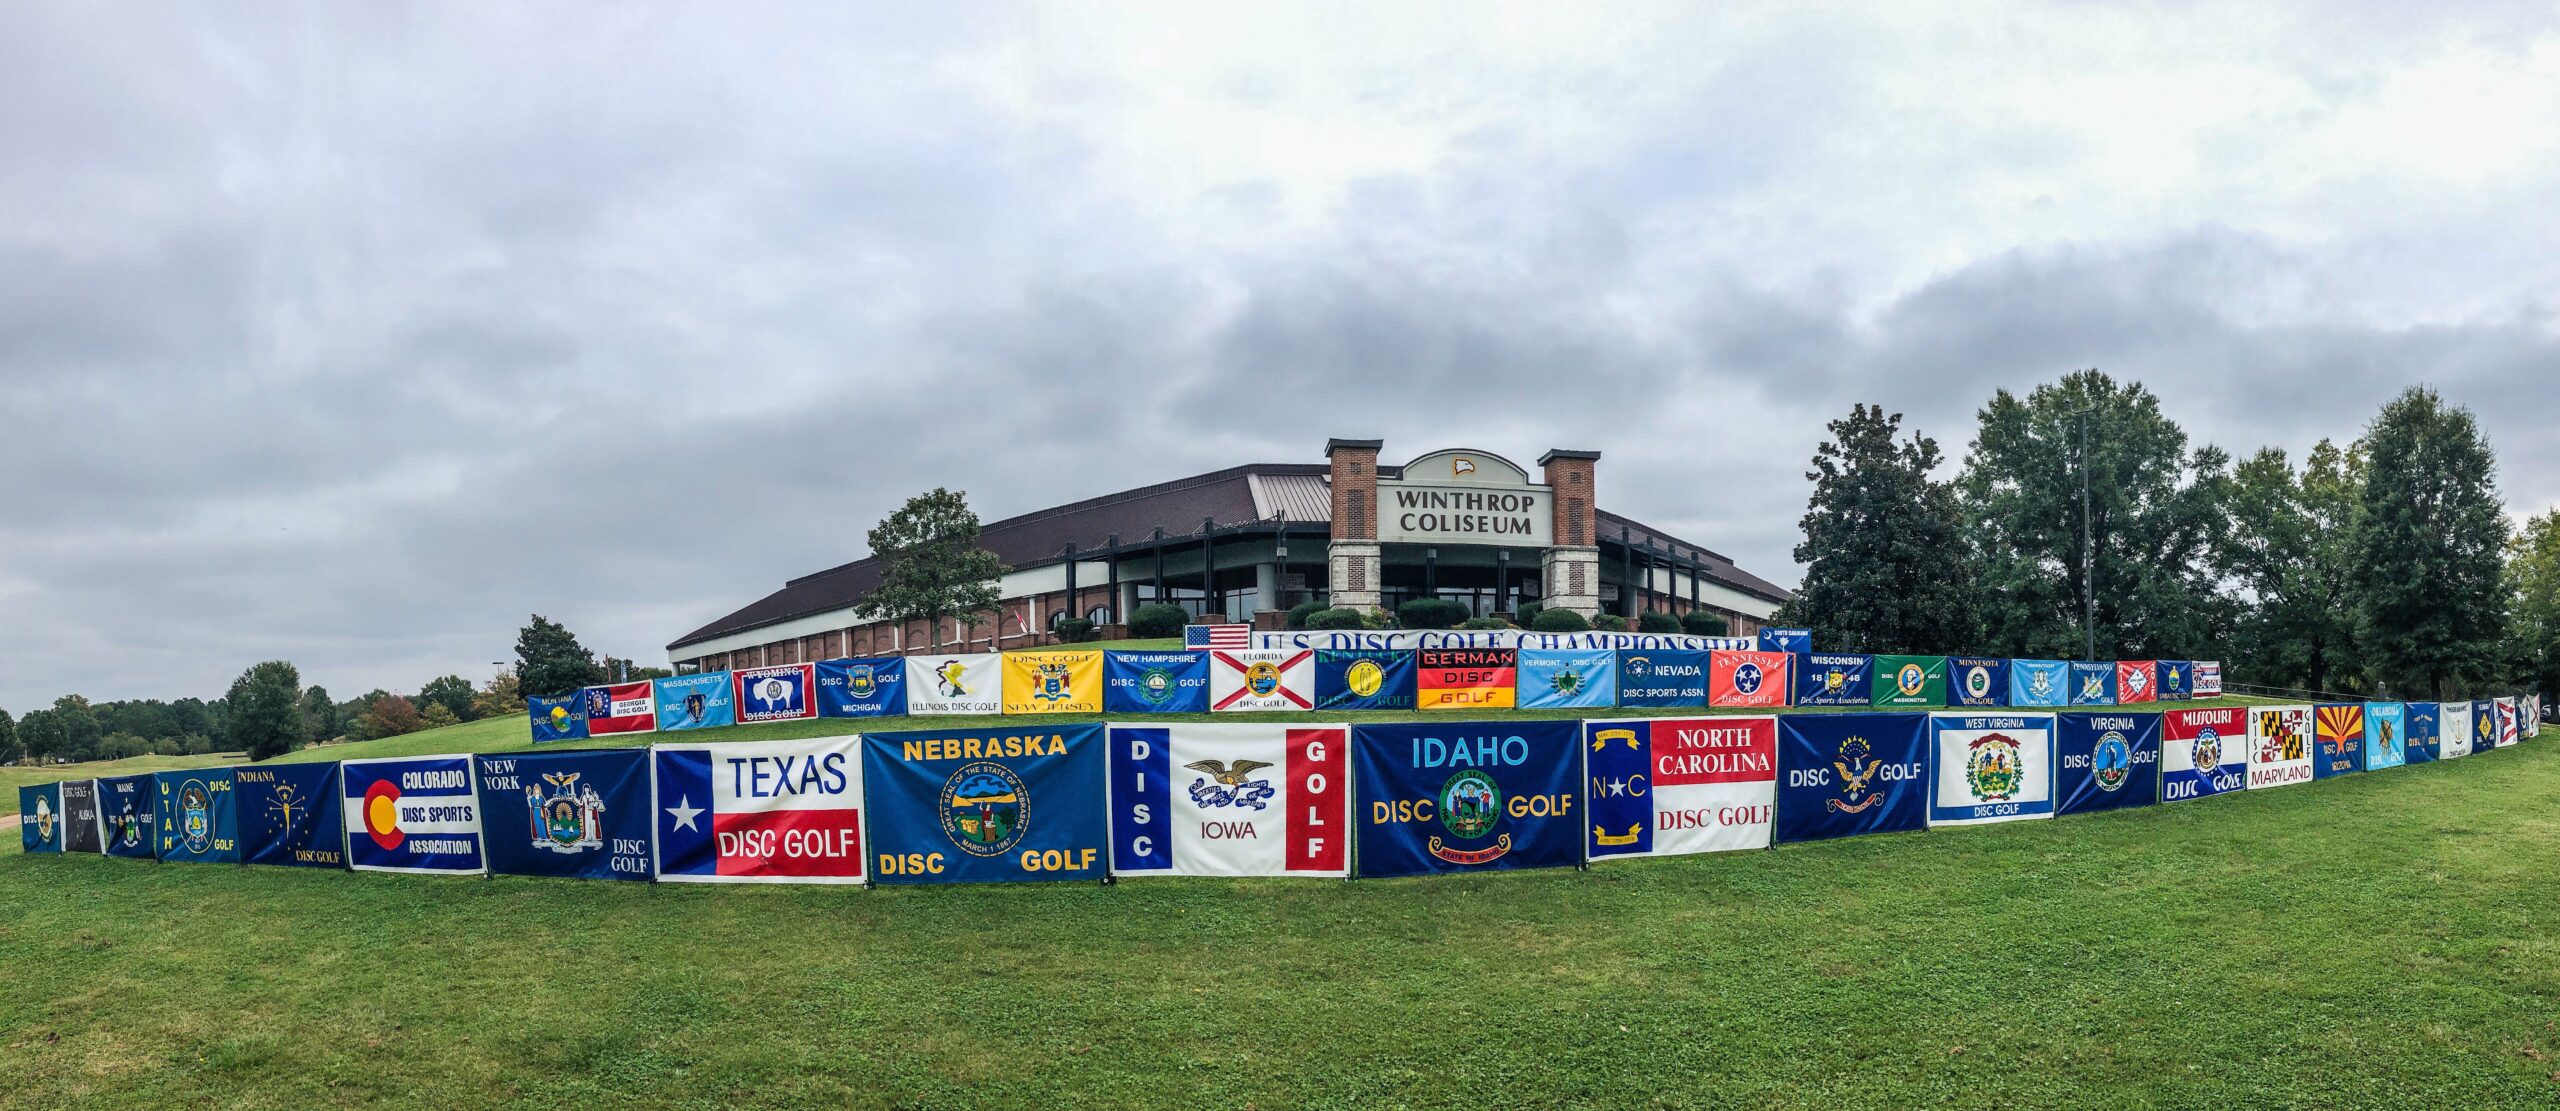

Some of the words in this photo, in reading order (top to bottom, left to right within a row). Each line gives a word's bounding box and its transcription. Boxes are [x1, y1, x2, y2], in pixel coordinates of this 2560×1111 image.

[1396, 490, 1535, 513] WINTHROP
[1400, 512, 1532, 535] COLISEUM
[1012, 655, 1047, 664] DISC
[1052, 654, 1095, 663] GOLF
[1117, 655, 1139, 663] NEW
[1141, 655, 1197, 663] HAMPSHIRE
[1423, 652, 1514, 665] GERMAN
[1524, 659, 1561, 667] VERMONT
[1572, 658, 1590, 666] DISC
[1592, 658, 1612, 666] GOLF
[1717, 654, 1781, 671] TENNESSEE
[1811, 656, 1864, 665] WISCONSIN
[1959, 659, 1999, 667] MINNESOTA
[746, 666, 800, 679] WYOMING
[1655, 665, 1701, 676] NEVADA
[2073, 662, 2113, 671] PENNSYLVANIA
[663, 675, 723, 688] MASSACHUSETTS
[821, 676, 842, 686] DISC
[878, 674, 900, 683] GOLF
[1111, 678, 1135, 687] DISC
[1179, 679, 1206, 687] GOLF
[1444, 671, 1493, 683] DISC
[1811, 674, 1822, 682] 18
[1440, 692, 1496, 703] GOLF
[1623, 689, 1644, 698] DISC
[1646, 689, 1677, 698] SPORTS
[1680, 688, 1705, 697] ASSN.
[619, 700, 646, 708] GEORGIA
[709, 698, 729, 707] GOLF
[1239, 700, 1260, 708] DISC
[1263, 700, 1288, 708] GOLF
[1377, 695, 1411, 706] GOLF
[1721, 695, 1746, 704] DISC
[1748, 695, 1774, 704] GOLF
[1814, 697, 1835, 705] Sports
[1837, 696, 1869, 704] Association
[1978, 697, 1995, 705] GOLF
[616, 707, 630, 715] DISC
[842, 703, 881, 712] MICHIGAN
[912, 702, 948, 711] ILLINOIS
[951, 702, 971, 711] DISC
[974, 702, 998, 711] GOLF
[1006, 703, 1042, 711] NEW
[1044, 702, 1097, 711] JERSEY
[747, 710, 772, 720] DISC
[775, 708, 803, 719] GOLF
[2182, 710, 2232, 727] MISSOURI
[533, 716, 551, 726] DISC
[1965, 718, 1986, 729] WEST
[1988, 718, 2025, 729] VIRGINIA
[2090, 717, 2135, 731] VIRGINIA
[1677, 728, 1752, 749] NORTH
[903, 734, 1068, 762] NEBRASKA
[1412, 736, 1529, 769] IDAHO
[2346, 742, 2358, 752] GOLF
[1658, 752, 1771, 775] CAROLINA
[2064, 754, 2089, 769] DISC
[2132, 750, 2157, 764] GOLF
[483, 759, 517, 775] NEW
[965, 766, 980, 775] THE
[983, 766, 1006, 778] STATE
[237, 771, 275, 783] INDIANA
[402, 770, 465, 790] COLORADO
[727, 752, 847, 798] TEXAS
[955, 774, 964, 784] OF
[1006, 776, 1017, 785] OF
[1445, 772, 1464, 791] GREAT
[1468, 771, 1485, 780] SEAL
[1790, 768, 1830, 788] DISC
[1880, 762, 1921, 782] GOLF
[2251, 764, 2311, 786] MARYLAND
[116, 782, 134, 792] MAINE
[209, 781, 231, 792] DISC
[484, 775, 520, 791] YORK
[1190, 780, 1204, 791] OUR
[1593, 776, 1606, 799] N
[1628, 774, 1646, 797] C
[2166, 779, 2199, 800] DISC
[2212, 772, 2243, 792] GOLF
[75, 786, 87, 797] GOLF
[944, 785, 956, 804] SEAL
[1194, 786, 1221, 799] LIBERTIES
[1258, 787, 1272, 796] WILL
[1131, 740, 1153, 857] DISC
[1200, 800, 1209, 808] WE
[1217, 799, 1229, 807] AND
[1306, 741, 1327, 859] GOLF
[402, 807, 425, 823] DISC
[428, 805, 473, 823] SPORTS
[1014, 786, 1027, 830] NEBRASKA
[1373, 799, 1434, 825] DISC
[1508, 793, 1572, 818] GOLF
[1974, 806, 1994, 818] DISC
[1996, 804, 2019, 816] GOLF
[23, 815, 37, 824] DISC
[140, 813, 153, 823] GOLF
[161, 782, 173, 850] UTAH
[943, 806, 956, 833] GREAT
[1658, 808, 1711, 831] DISC
[1718, 804, 1772, 826] GOLF
[1201, 821, 1257, 840] IOWA
[214, 839, 234, 851] GOLF
[409, 840, 472, 855] ASSOCIATION
[613, 838, 646, 855] DISC
[718, 832, 776, 859] DISC
[784, 828, 854, 858] GOLF
[961, 838, 988, 853] MARCH
[996, 837, 1011, 850] 1867
[295, 851, 316, 862] DISC
[317, 852, 340, 864] GOLF
[1442, 850, 1463, 860] STATE
[1479, 849, 1499, 860] IDAHO
[610, 856, 648, 873] GOLF
[879, 852, 945, 875] DISC
[1021, 848, 1097, 871] GOLF
